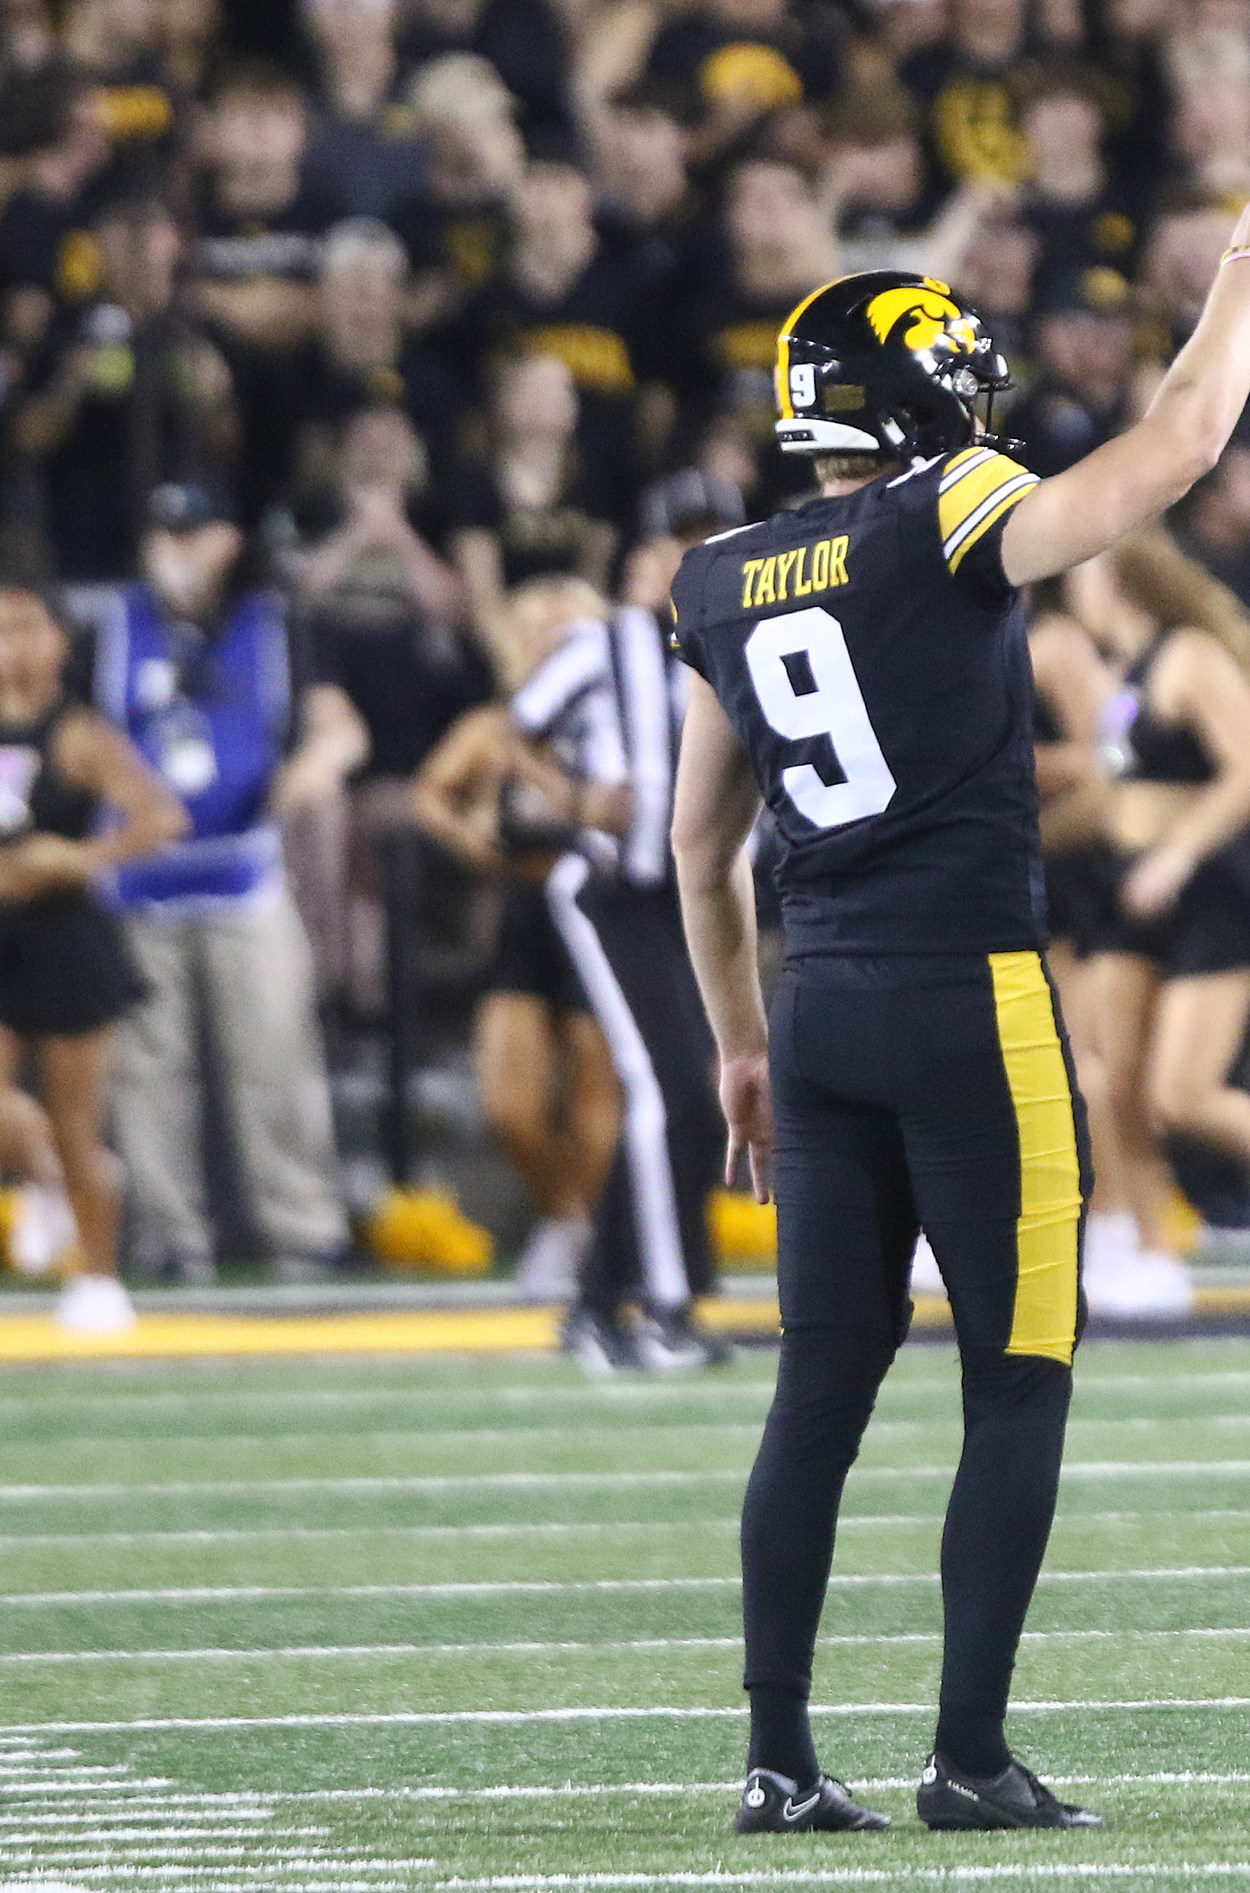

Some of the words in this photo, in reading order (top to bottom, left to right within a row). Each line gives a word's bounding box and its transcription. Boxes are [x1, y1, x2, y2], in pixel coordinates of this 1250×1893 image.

[790, 363, 816, 408] 9
[743, 535, 850, 608] TAYLOR
[744, 605, 897, 828] 9
